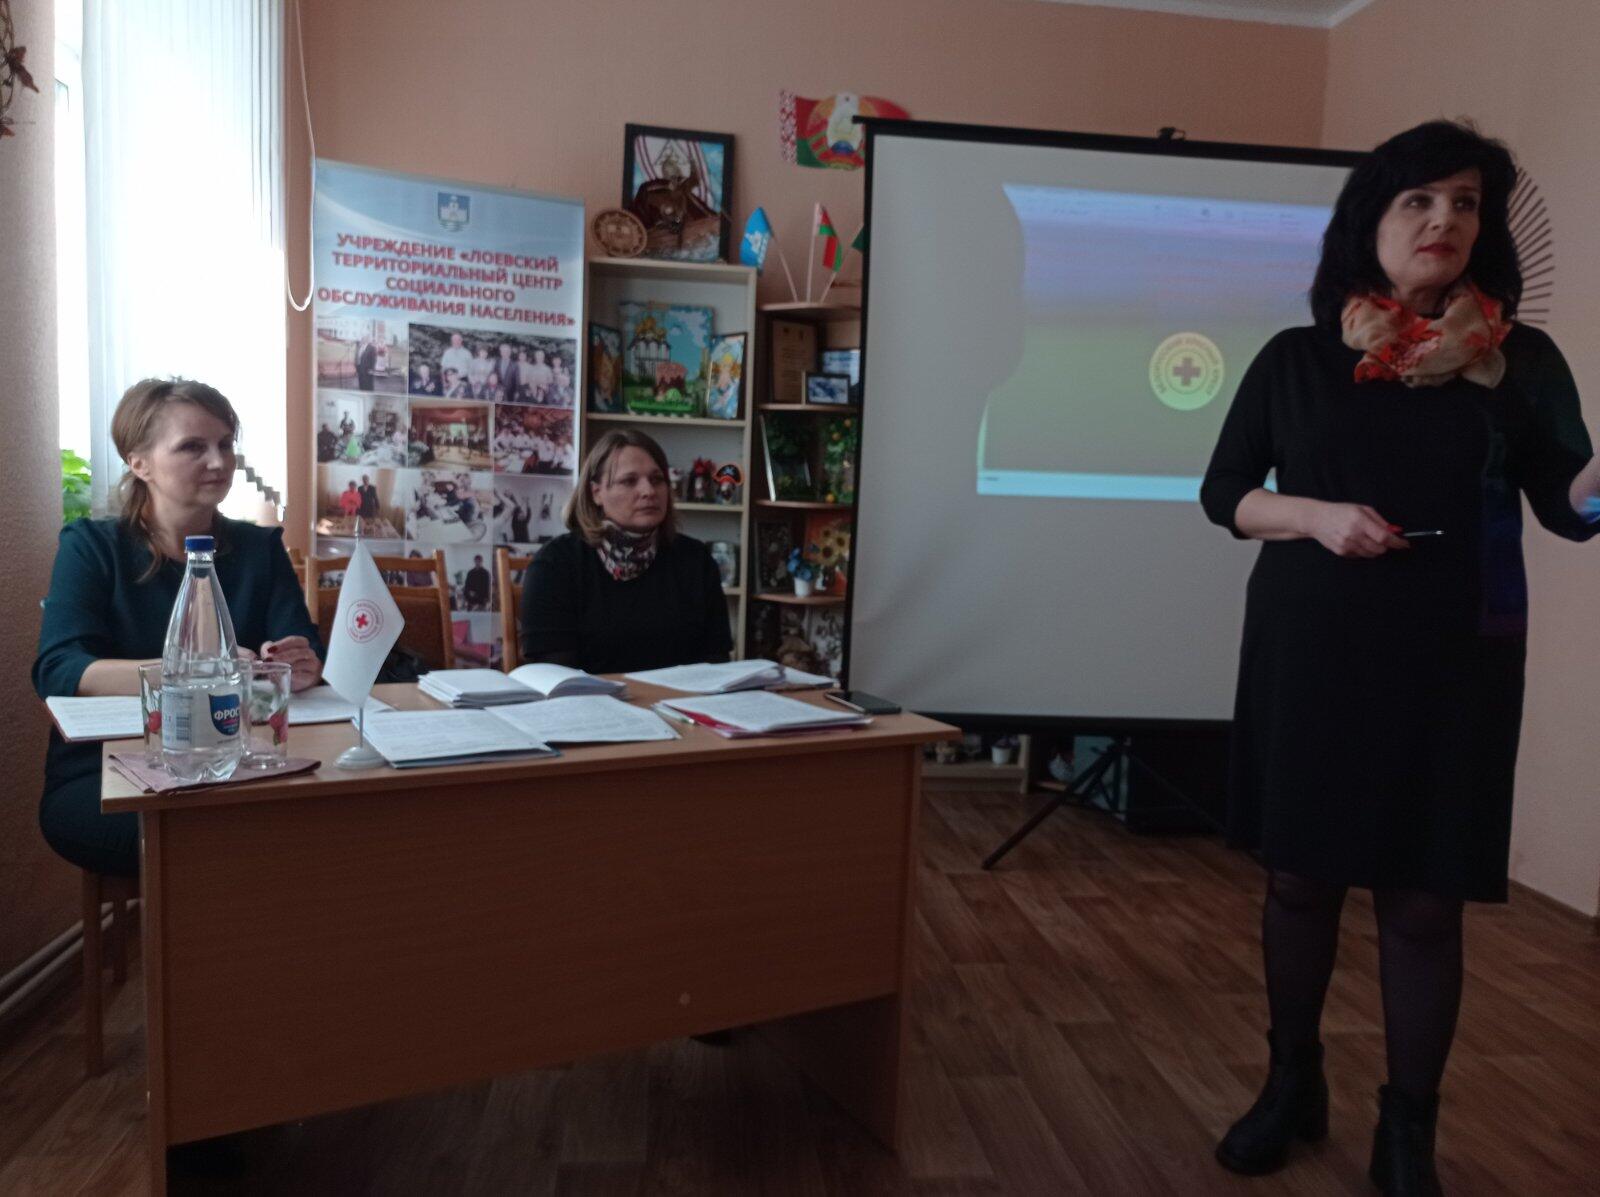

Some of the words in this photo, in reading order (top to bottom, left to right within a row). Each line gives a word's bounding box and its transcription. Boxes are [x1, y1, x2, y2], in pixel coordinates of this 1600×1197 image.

[332, 251, 508, 284] ТЕРРИТОРИАЛЬНЫЙ
[512, 274, 563, 291] ЦЕНТР
[337, 232, 456, 261] УЧРЕЖДЕНИЕ
[460, 248, 559, 273] «ЛОЕВСКИЙ
[317, 287, 466, 316] ОБСЛУЖИВАНИЯ
[470, 305, 575, 327] НАСЕЛЕНИЯ»
[386, 277, 515, 302] СОЦИАЛЬНОГО
